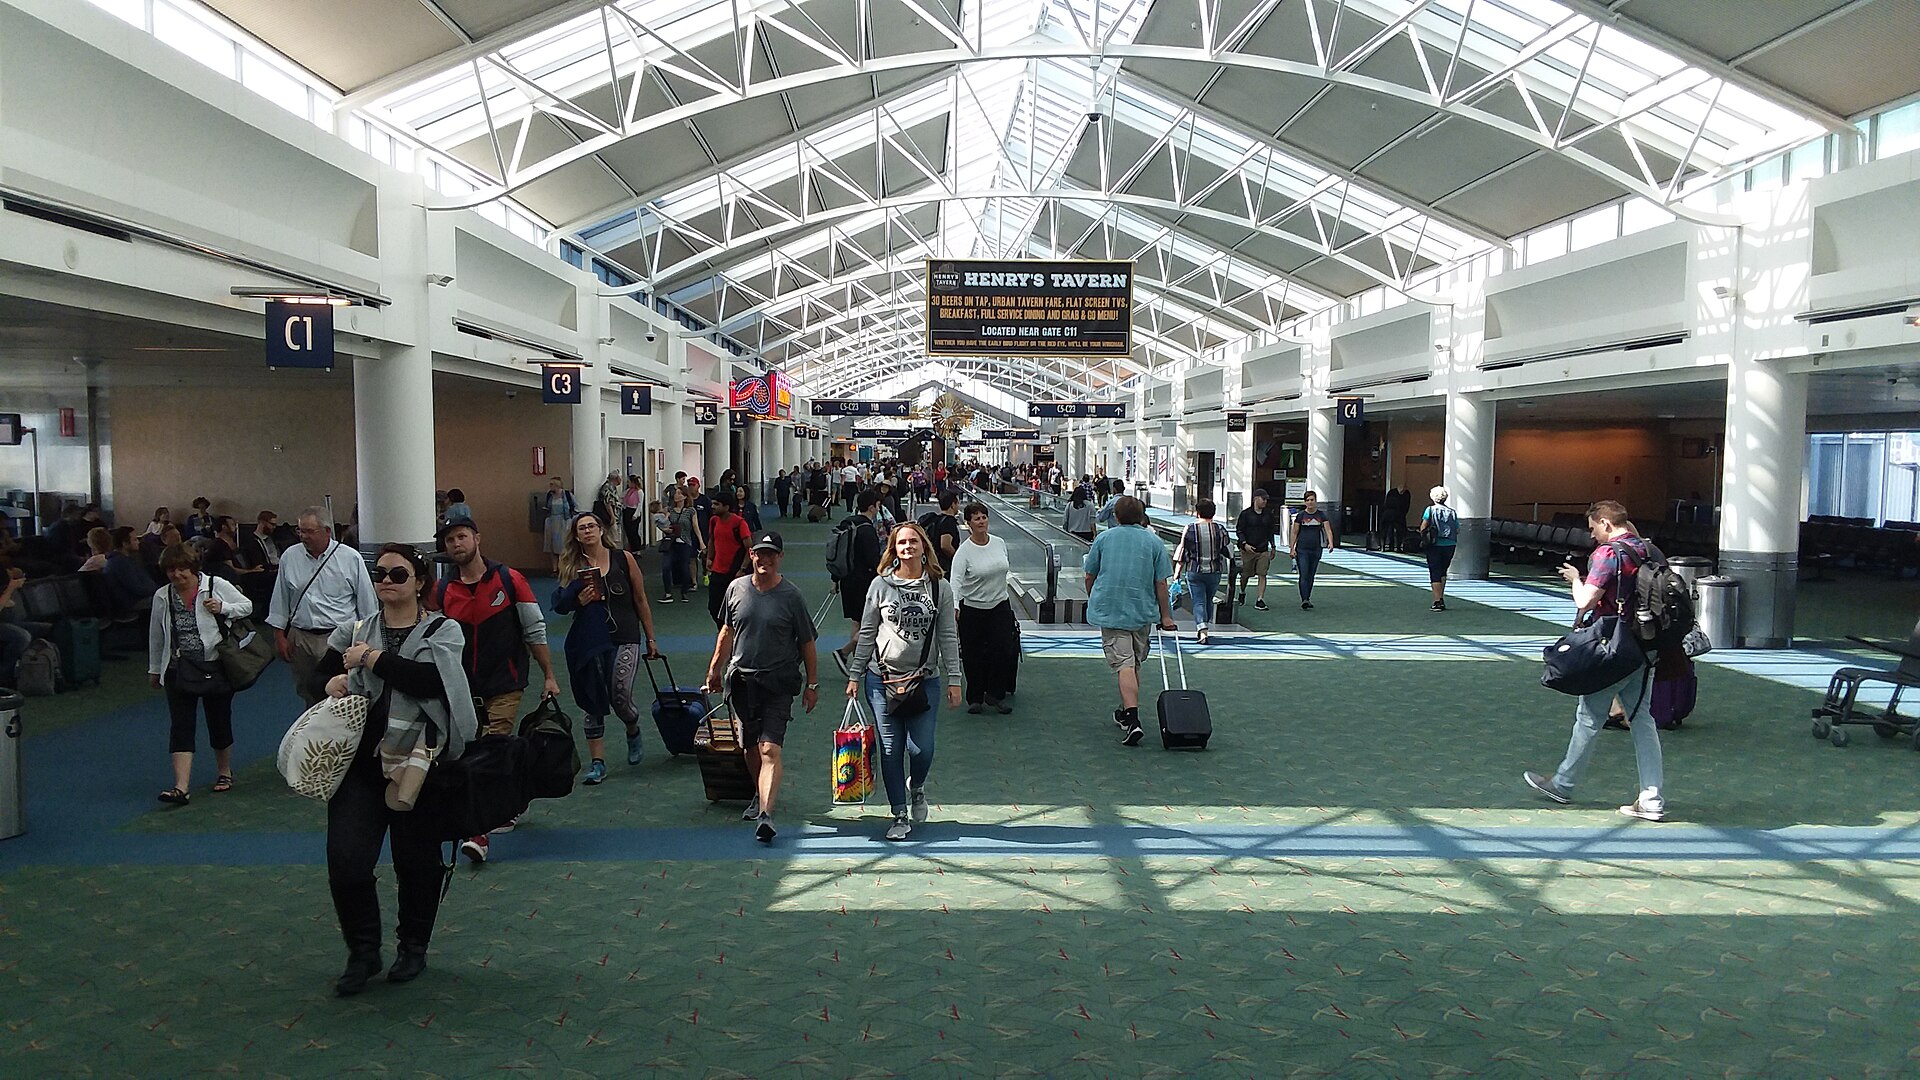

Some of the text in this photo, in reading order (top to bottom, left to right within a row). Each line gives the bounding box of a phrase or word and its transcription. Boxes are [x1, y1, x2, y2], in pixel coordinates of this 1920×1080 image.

[964, 272, 1127, 288] HENRY'S TAVERN
[931, 295, 940, 306] 30
[942, 296, 963, 306] BEERS
[964, 296, 973, 306] ON
[975, 296, 991, 307] TAP,
[992, 296, 1015, 306] URBAN
[1017, 296, 1043, 307] TAVERN
[1045, 297, 1064, 308] FARE,
[1066, 297, 1082, 307] FLAT
[1084, 297, 1110, 307] SCREEN
[940, 308, 1119, 320] BREAKFAST, FULL SERVICE DINING AND GRAB & GO MENU!
[285, 316, 312, 350] C1
[982, 326, 1077, 336] LOCATED NEAR GATE C11
[551, 373, 571, 396] C3
[840, 403, 859, 411] C5-C23
[1344, 404, 1357, 418] C4
[888, 592, 935, 614] SAN FRANCISCO
[896, 628, 928, 640] 1850
